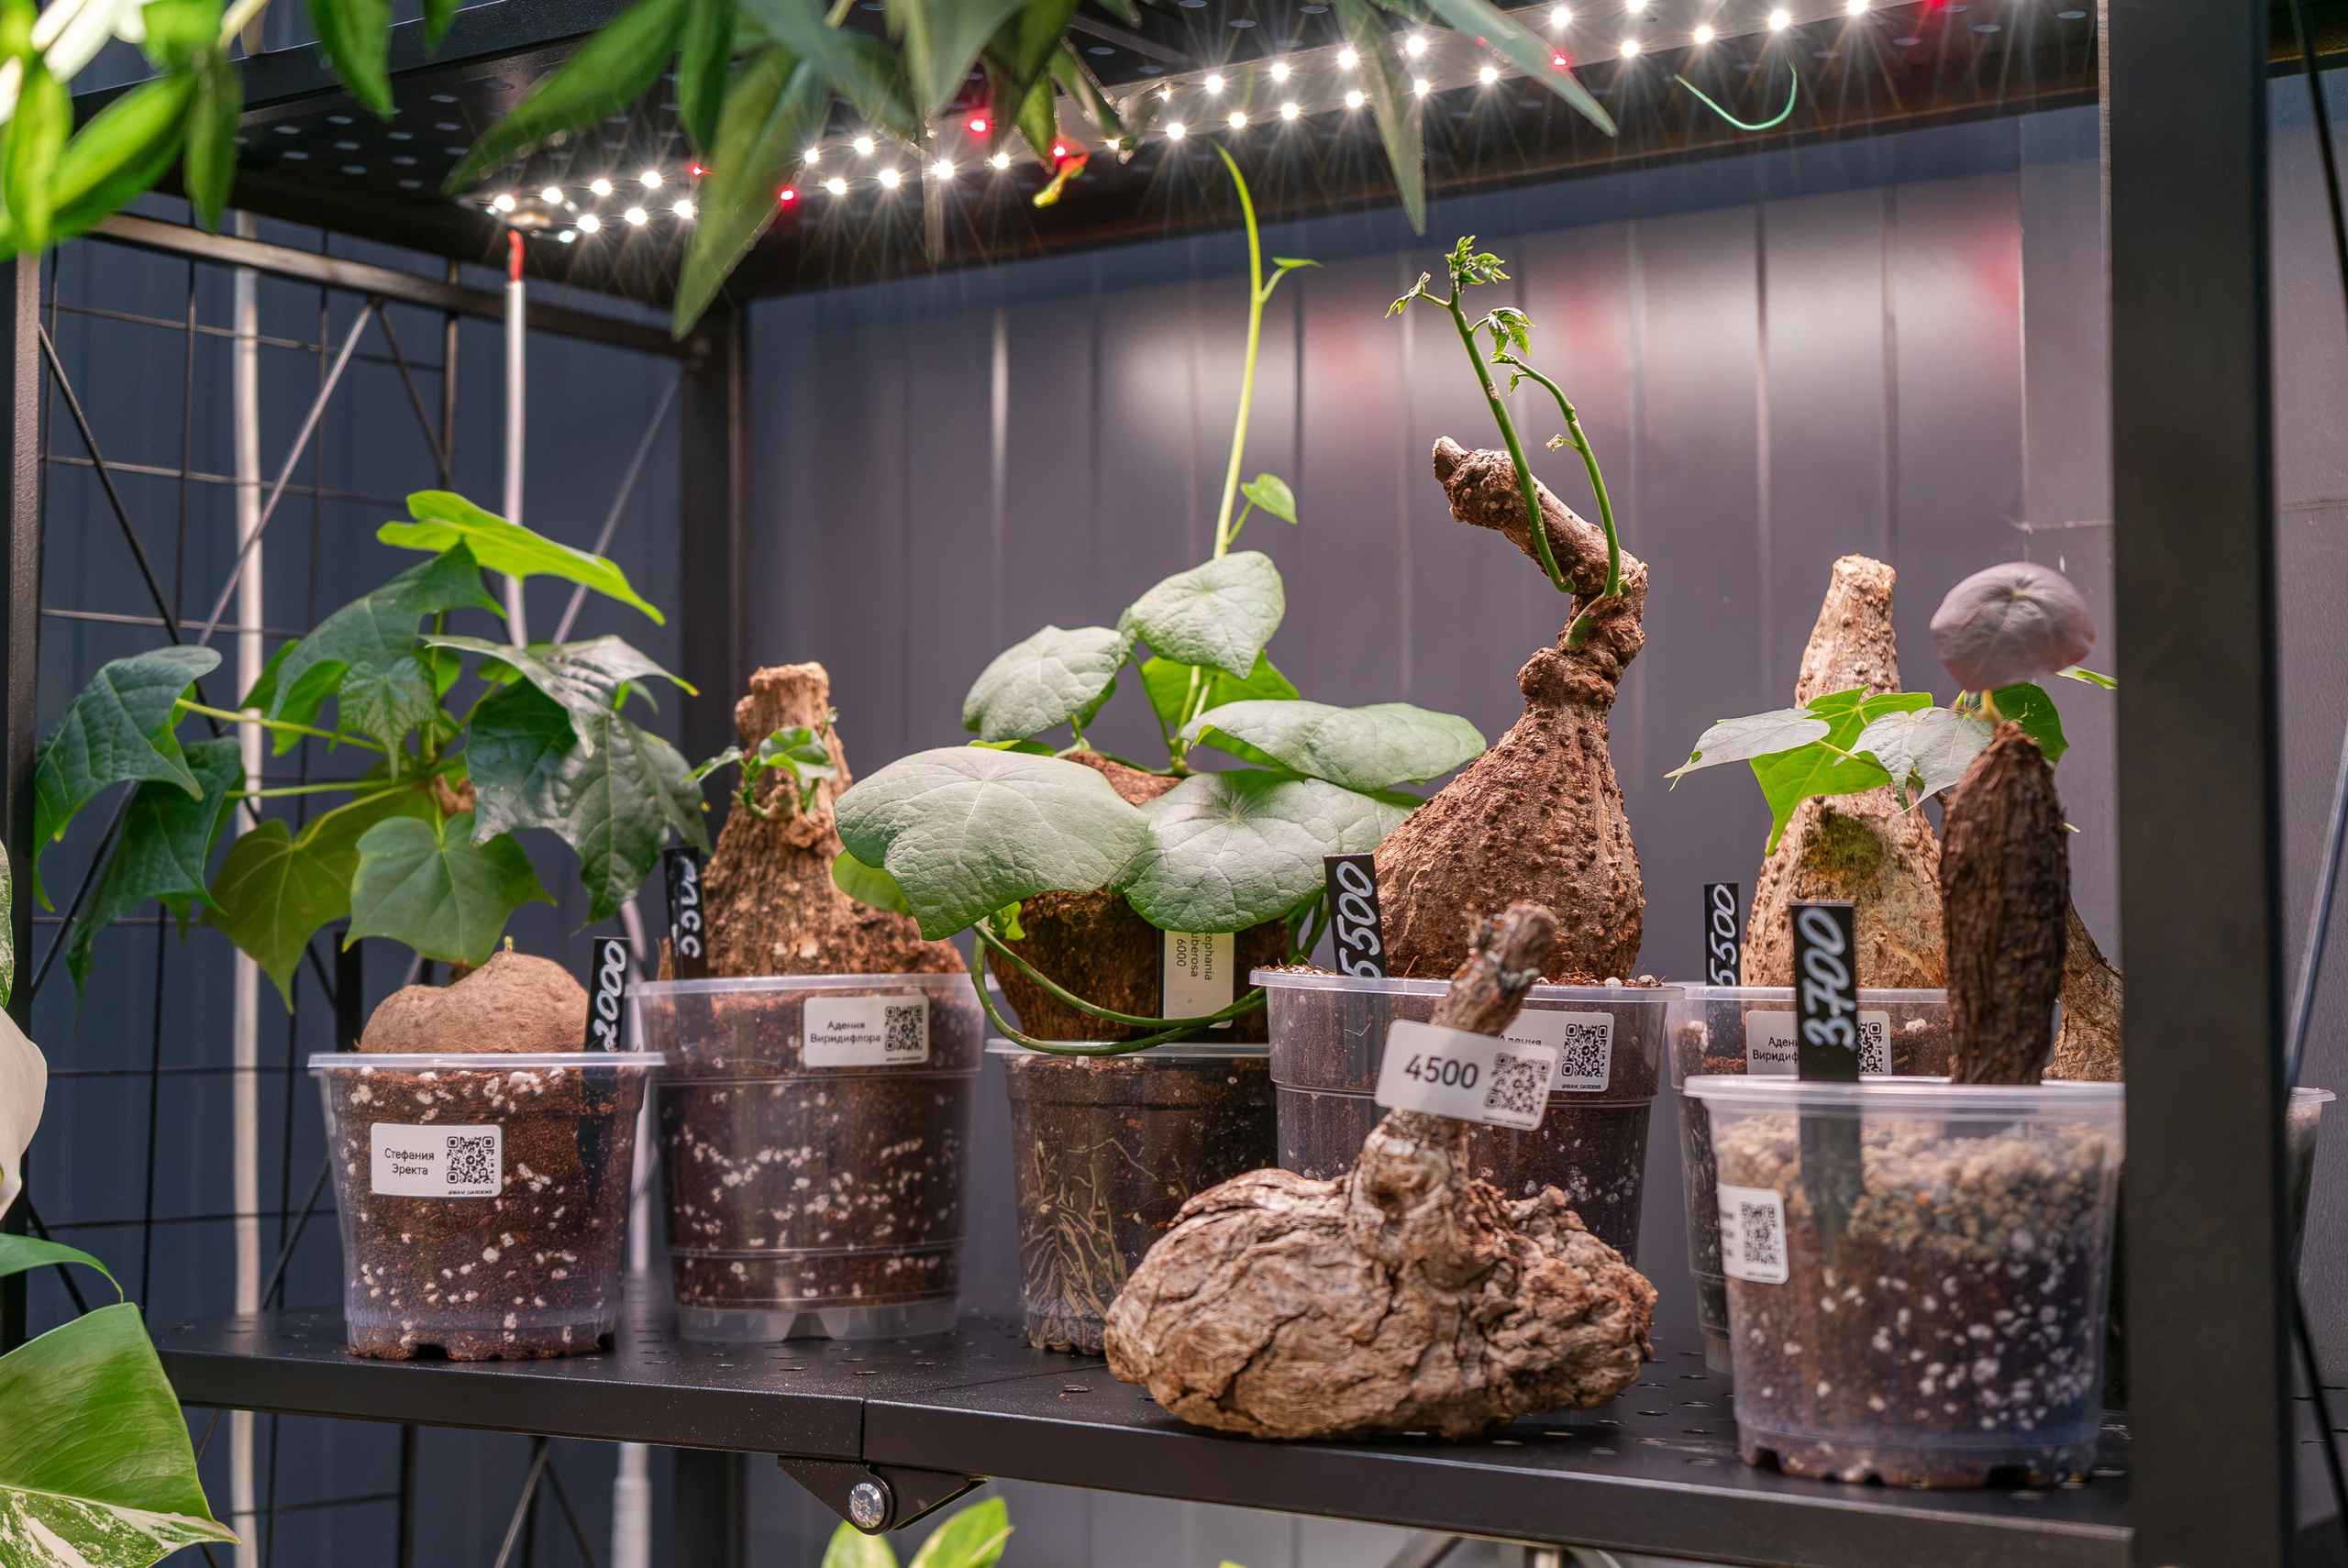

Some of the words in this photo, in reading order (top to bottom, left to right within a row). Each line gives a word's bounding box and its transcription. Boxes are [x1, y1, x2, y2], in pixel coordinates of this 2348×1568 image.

[1335, 860, 1382, 978] 5500
[1709, 883, 1737, 988] 5500
[1176, 938, 1187, 967] 6000
[1797, 906, 1856, 1052] 3700
[593, 940, 626, 1053] 2000
[810, 1032, 881, 1045] Виридифлора
[827, 1021, 866, 1032] Адения
[1405, 1054, 1480, 1090] 4500
[384, 1147, 435, 1161] Стефания
[392, 1163, 428, 1176] Эректа
